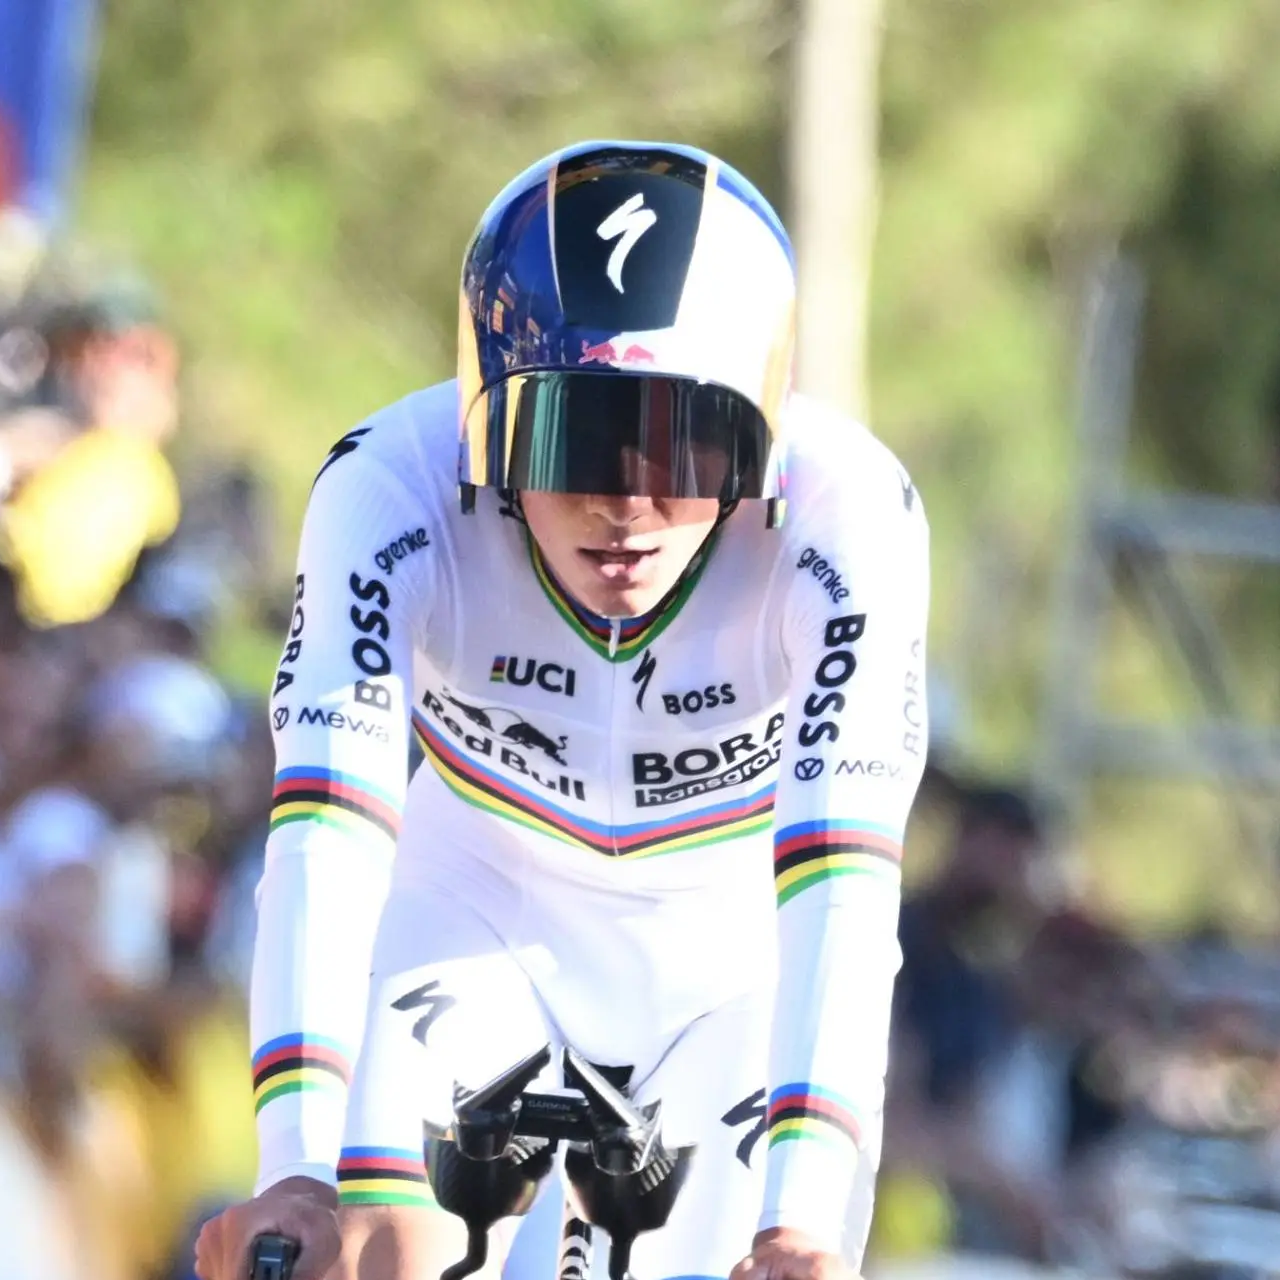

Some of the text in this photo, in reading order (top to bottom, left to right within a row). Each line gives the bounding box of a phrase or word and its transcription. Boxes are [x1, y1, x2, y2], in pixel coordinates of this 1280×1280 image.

[374, 527, 430, 576] grenke
[796, 547, 850, 604] grenke
[349, 571, 392, 712] BOSS
[507, 656, 576, 697] UCI
[661, 683, 737, 716] BOSS
[798, 613, 867, 748] BOSS
[422, 689, 586, 802] Red Bull
[632, 711, 785, 786] BORA
[642, 741, 783, 806] hansgroh
